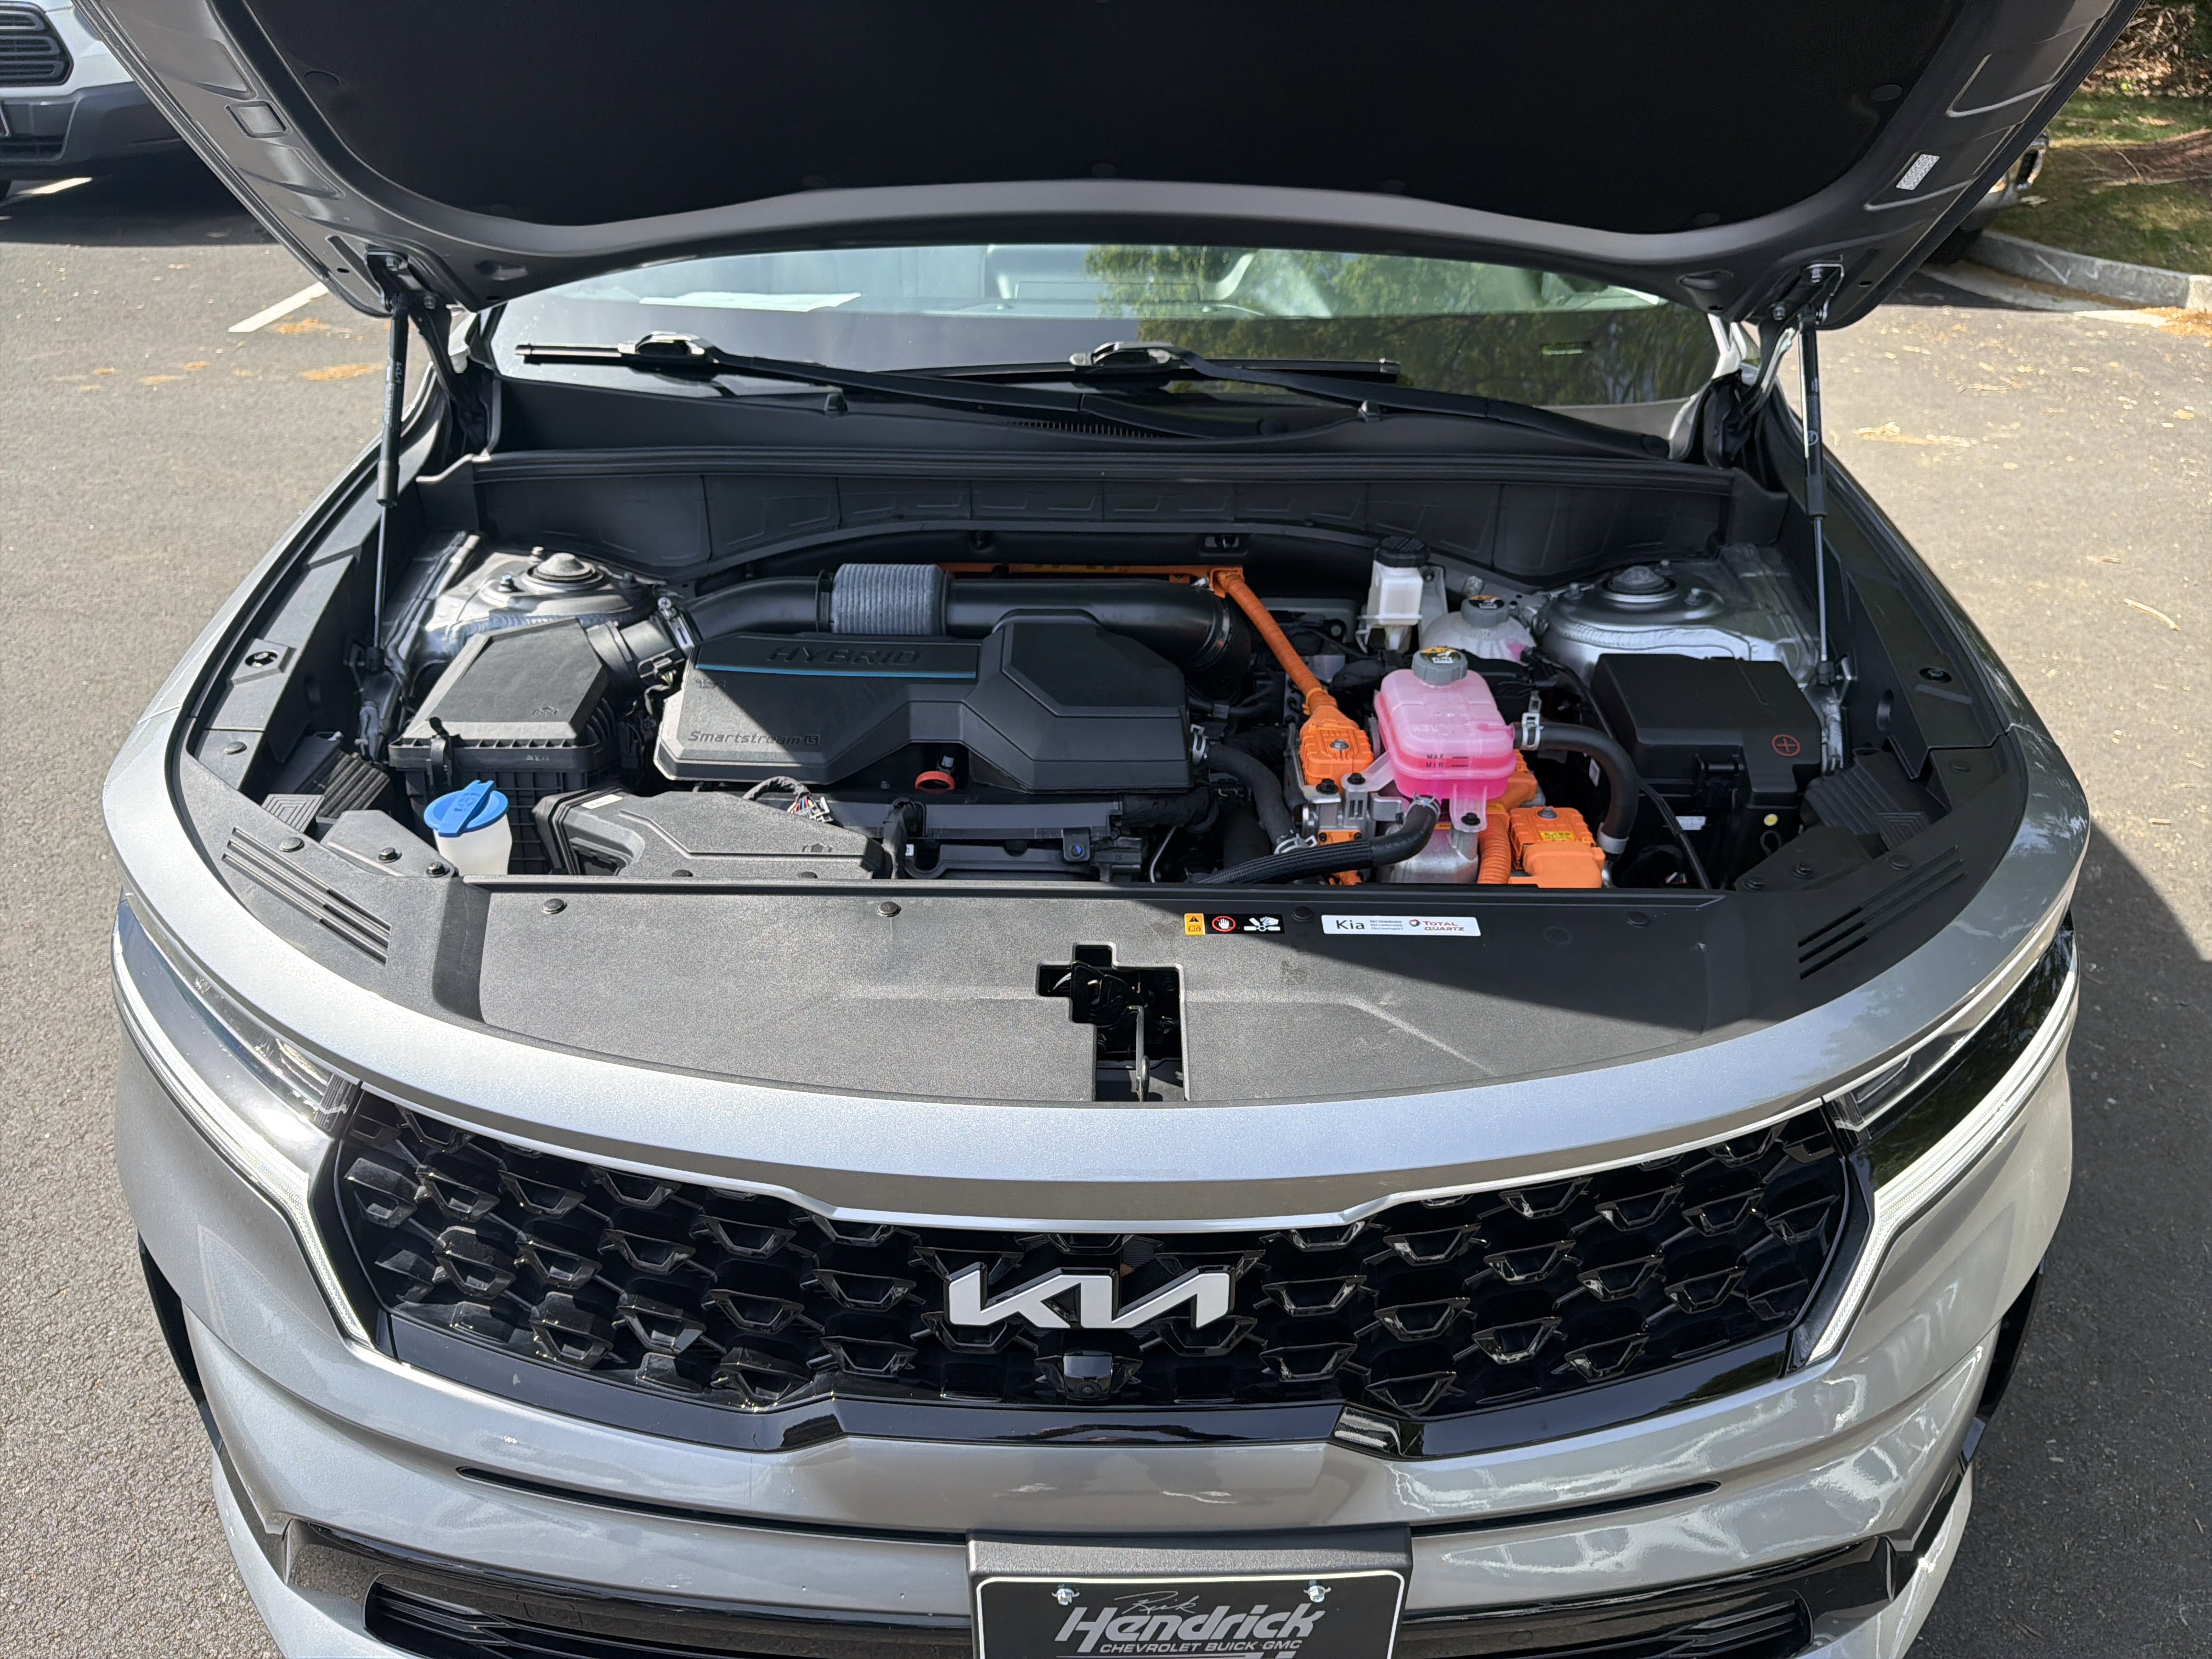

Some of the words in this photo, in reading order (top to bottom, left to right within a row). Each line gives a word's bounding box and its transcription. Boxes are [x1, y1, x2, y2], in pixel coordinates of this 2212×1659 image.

[766, 646, 920, 665] HYBRID
[687, 731, 803, 746] Smartstream
[1335, 919, 1365, 930] Kia
[946, 1262, 1234, 1329] KIA
[1054, 1603, 1326, 1653] Hendrick
[1099, 1643, 1202, 1653] CHEVROLET
[1204, 1641, 1261, 1652] BUICK
[1262, 1640, 1303, 1650] GMC
